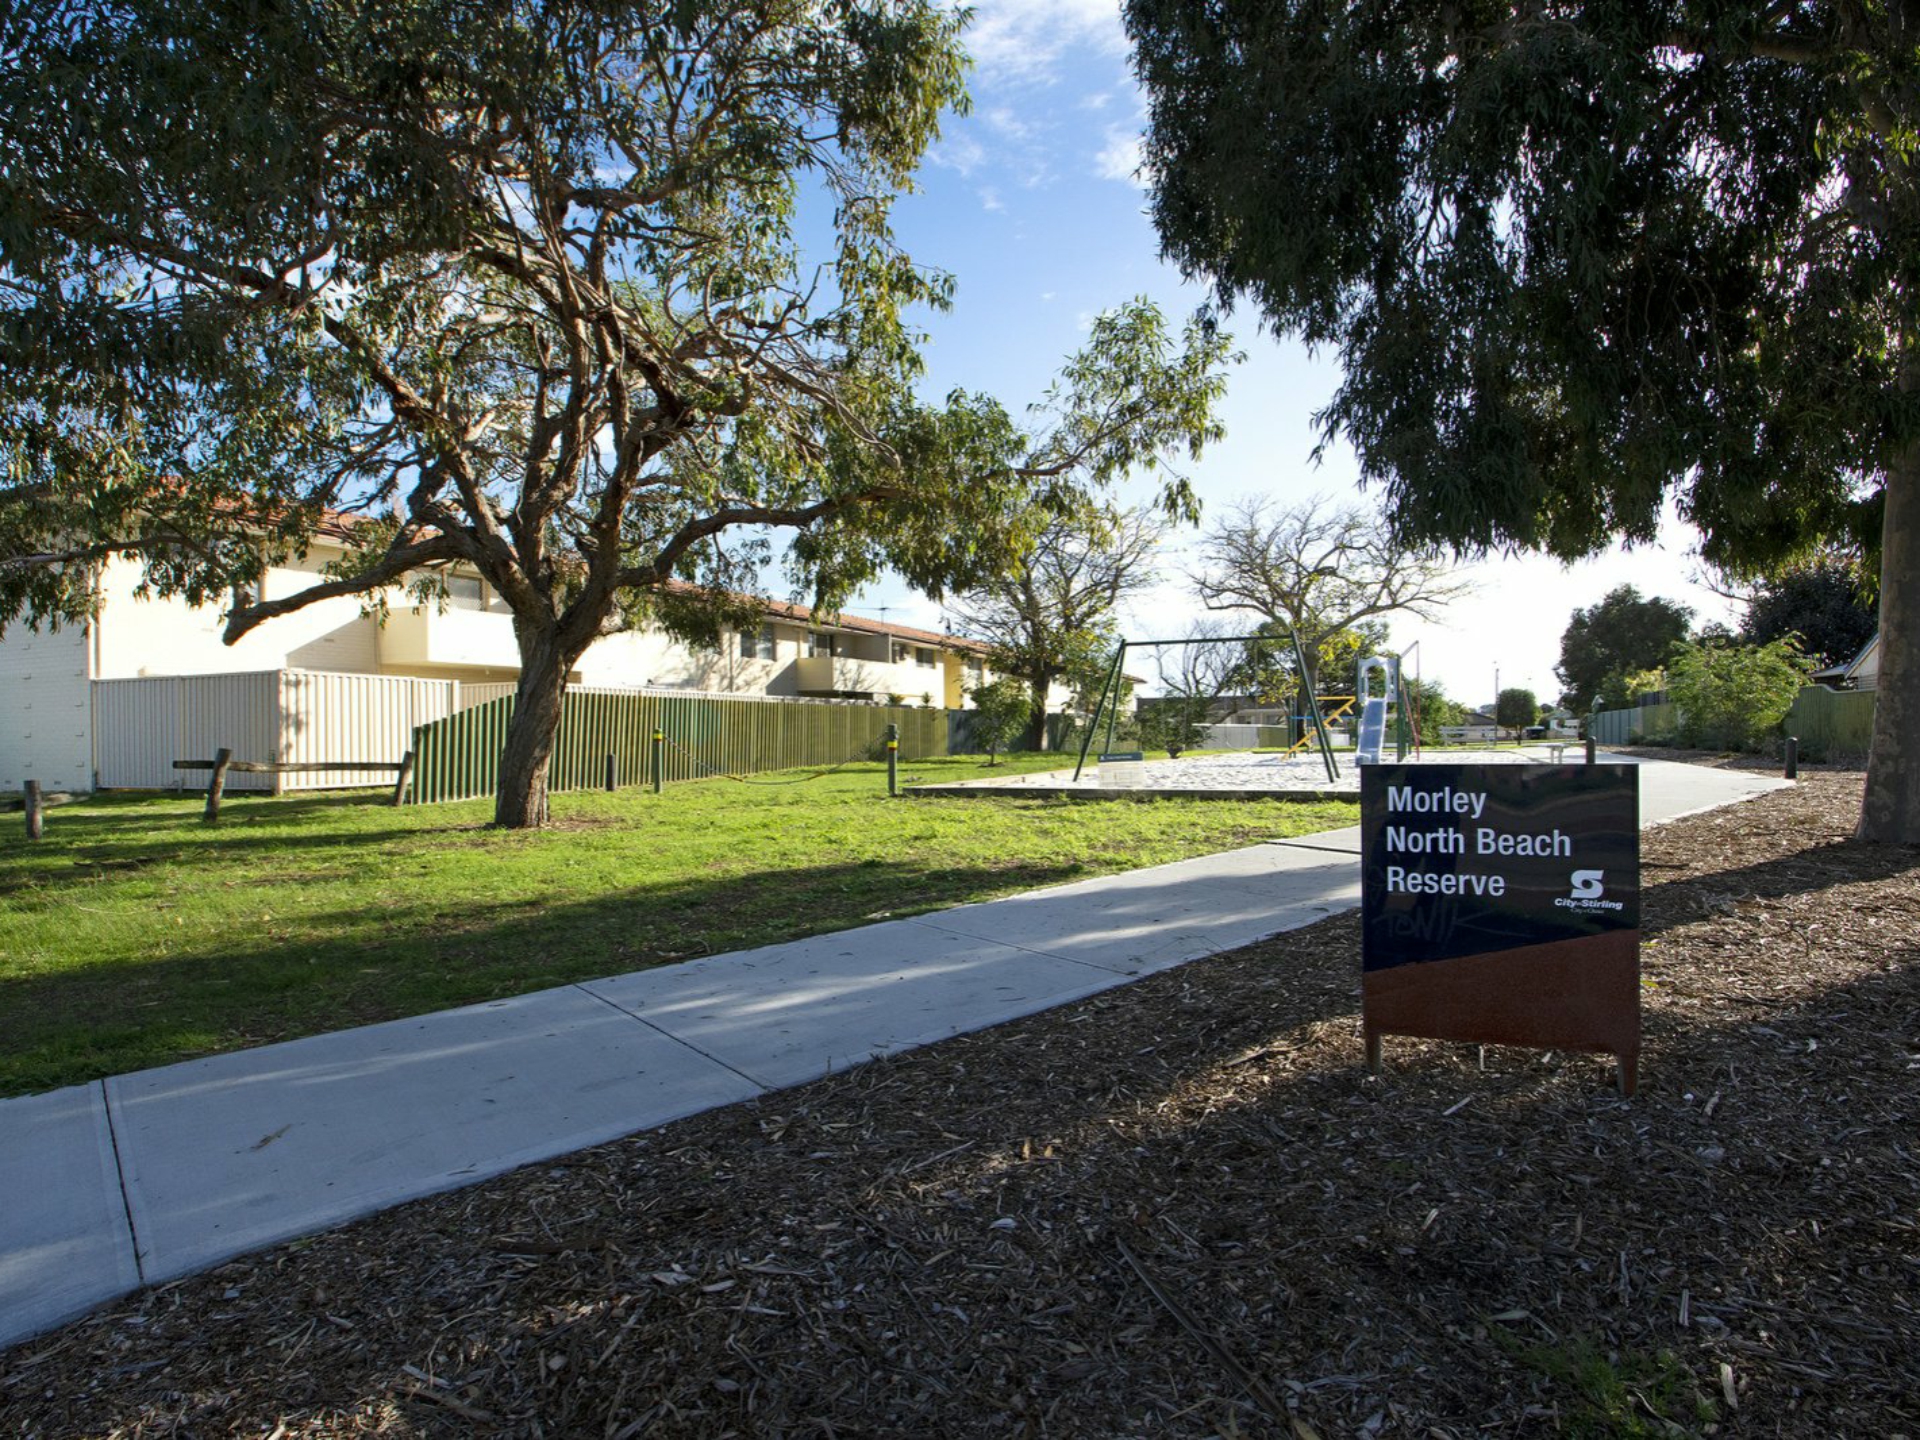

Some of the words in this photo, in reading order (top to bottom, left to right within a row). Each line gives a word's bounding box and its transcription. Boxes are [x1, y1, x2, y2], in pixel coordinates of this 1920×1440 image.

[1387, 786, 1487, 819] Morley
[1386, 827, 1465, 853] North
[1476, 828, 1571, 857] Beach
[1387, 866, 1505, 897] Reserve
[1554, 898, 1577, 908] City
[1581, 899, 1624, 911] Stirling
